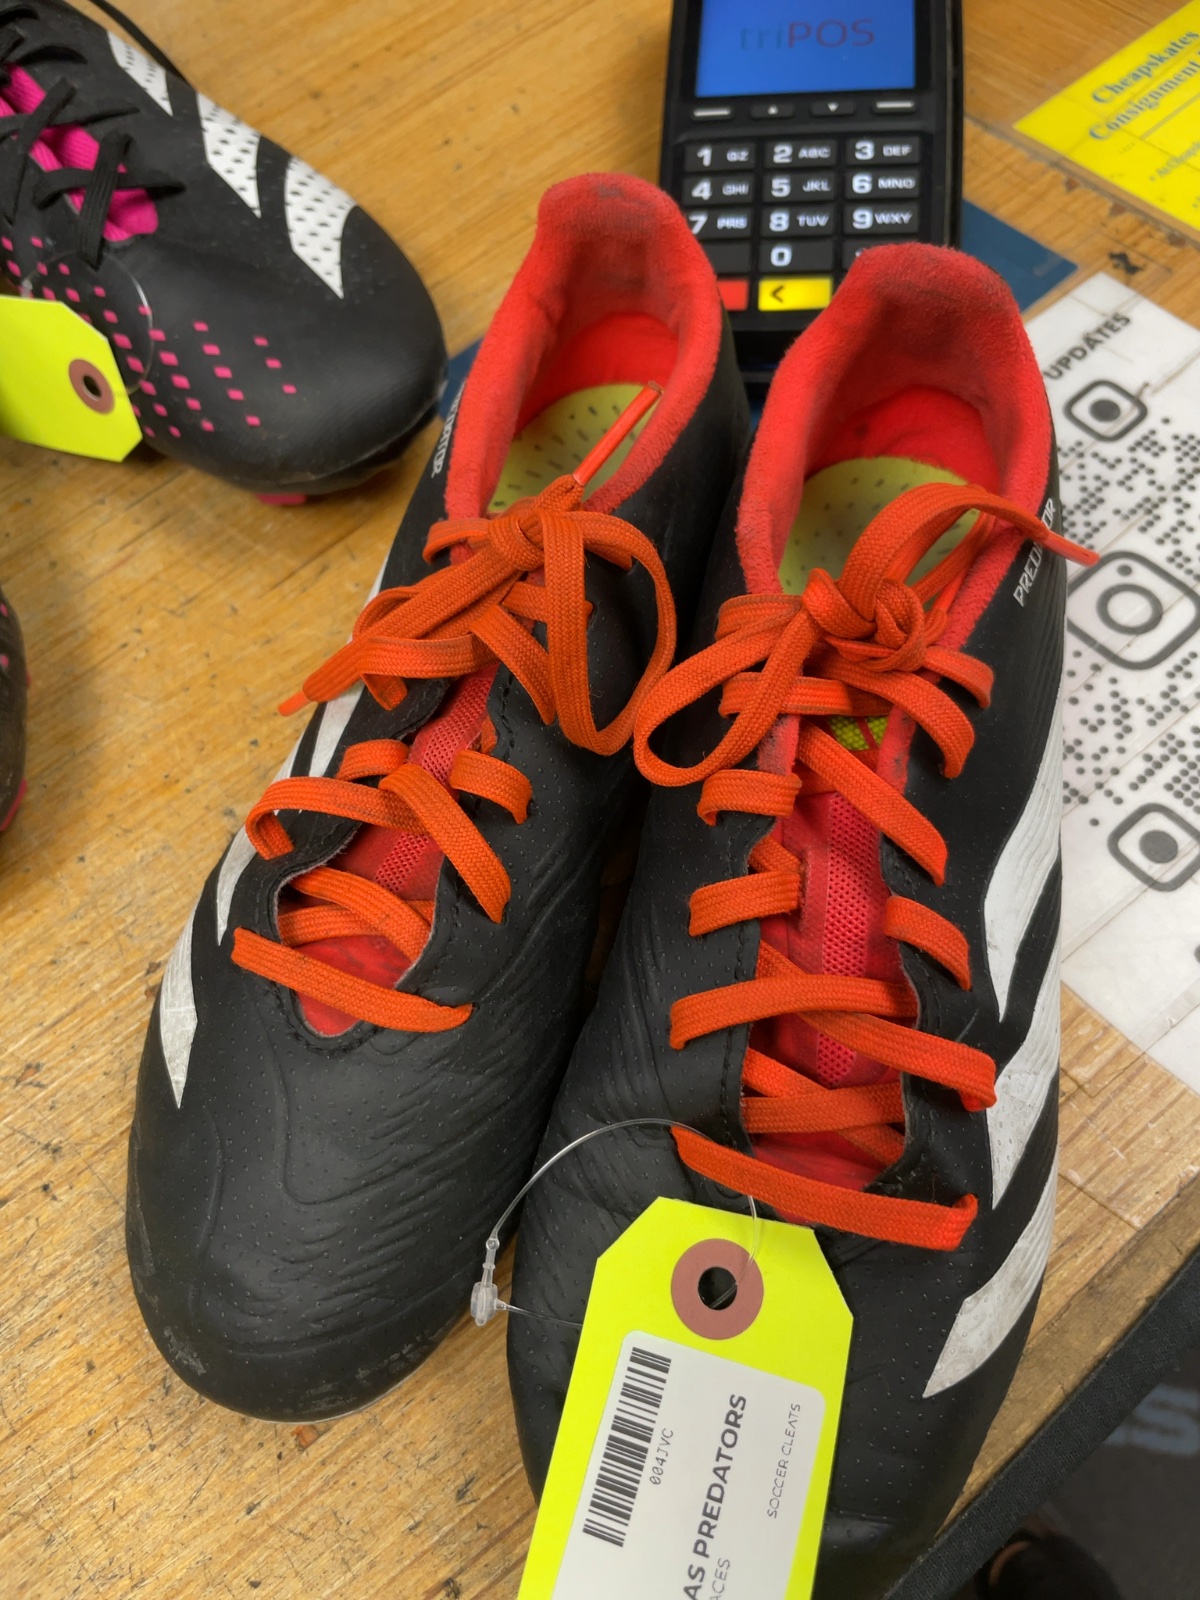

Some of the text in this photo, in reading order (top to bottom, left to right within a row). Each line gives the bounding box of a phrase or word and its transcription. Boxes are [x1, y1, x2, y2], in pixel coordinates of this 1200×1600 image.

[740, 18, 876, 49] triPOS
[1091, 30, 1200, 104] Cheapskates
[1088, 58, 1200, 140] Consignment
[698, 146, 712, 166] 1
[773, 143, 831, 163] 2 ABC
[855, 140, 912, 160] 3 DEF
[691, 179, 748, 200] 4 GHI
[771, 176, 831, 197] 5 JKL
[852, 173, 916, 194] 6 MNO
[689, 211, 708, 235] 7
[769, 210, 829, 232] 8 TUV
[852, 208, 912, 230] 9 WXY
[770, 246, 792, 267] 0
[1043, 312, 1130, 379] UPDATES
[1013, 498, 1055, 608] PREDOR
[649, 1427, 674, 1485] 004JVC
[767, 1403, 801, 1519] SOCCER CLEATS
[692, 1394, 747, 1559] PREDATORS
